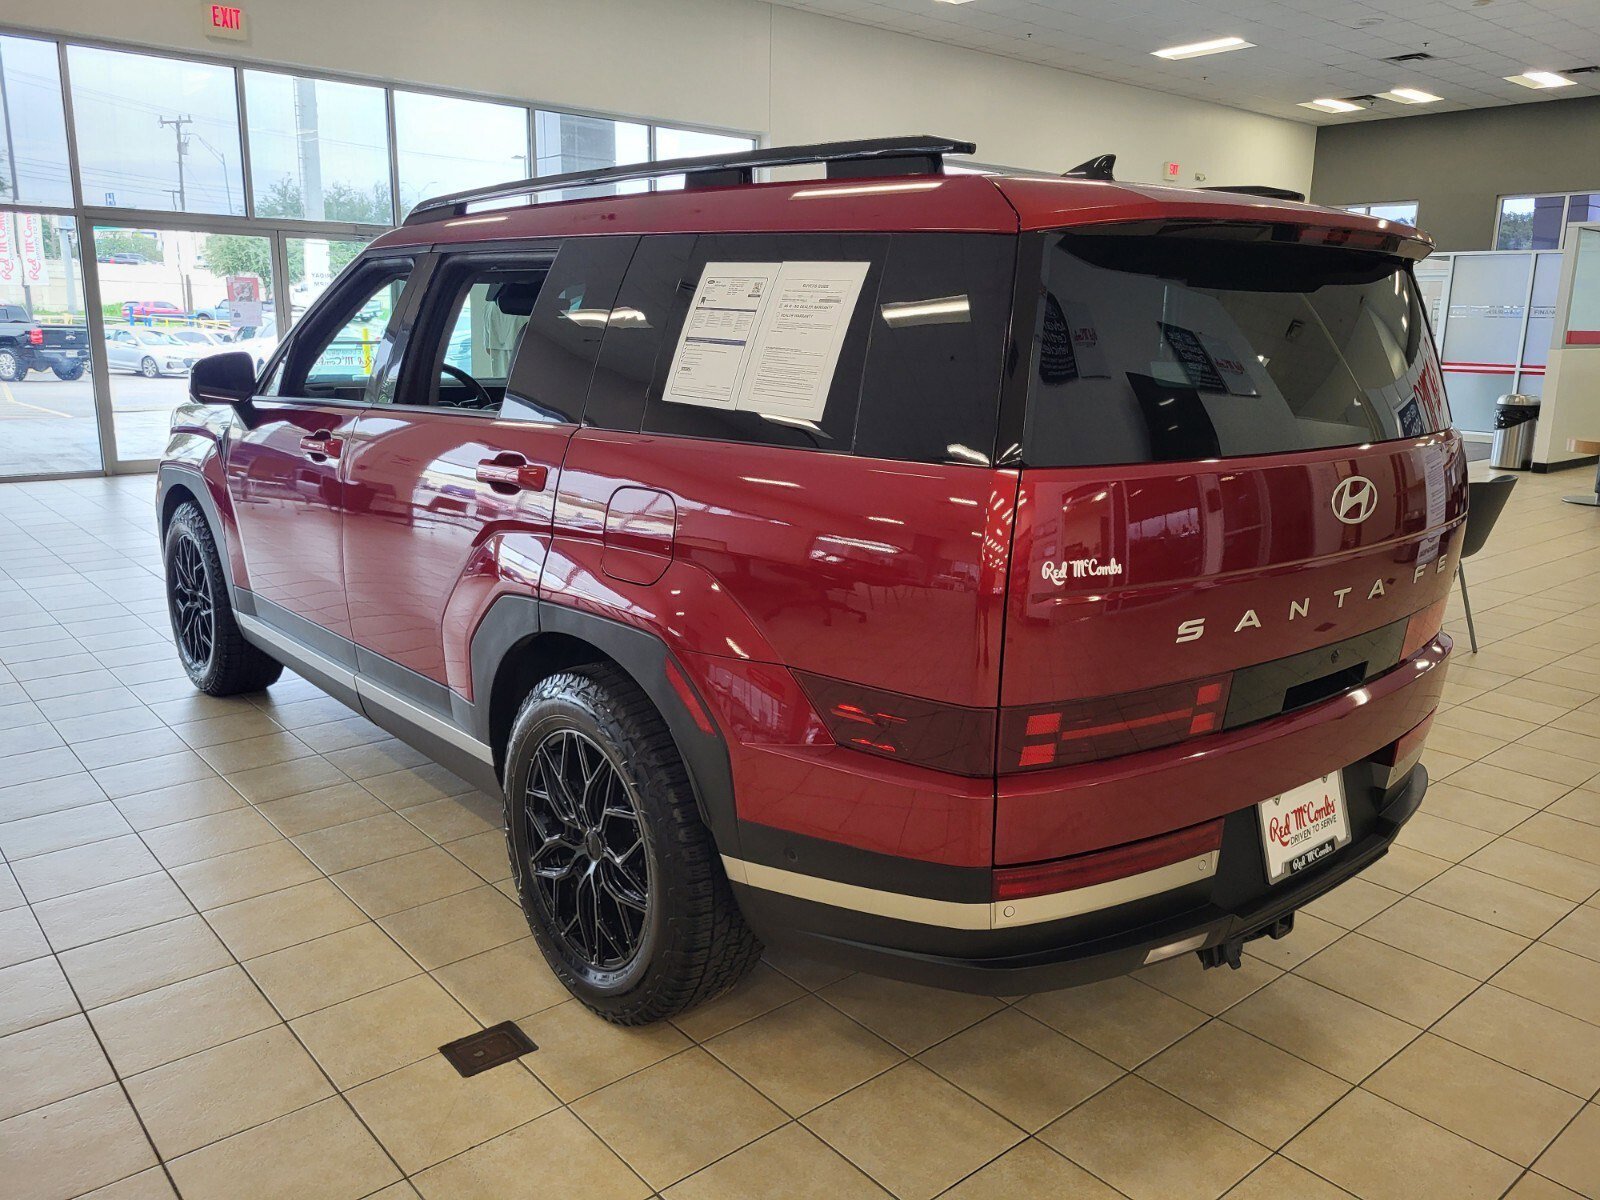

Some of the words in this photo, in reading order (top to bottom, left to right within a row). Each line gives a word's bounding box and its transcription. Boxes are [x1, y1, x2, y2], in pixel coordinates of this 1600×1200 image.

[212, 5, 240, 30] EXIT
[28, 258, 41, 280] Red
[1041, 561, 1067, 586] Red
[1069, 557, 1122, 578] McCombs
[1175, 578, 1386, 643] SANTA
[1413, 554, 1448, 584] FE
[1269, 813, 1291, 847] Red
[1291, 794, 1336, 830] McCombs
[1290, 828, 1311, 845] DRIVEN
[1311, 823, 1320, 834] TO
[1320, 814, 1337, 830] SERVE
[1292, 855, 1306, 870] Red
[1305, 843, 1333, 863] McCombs
